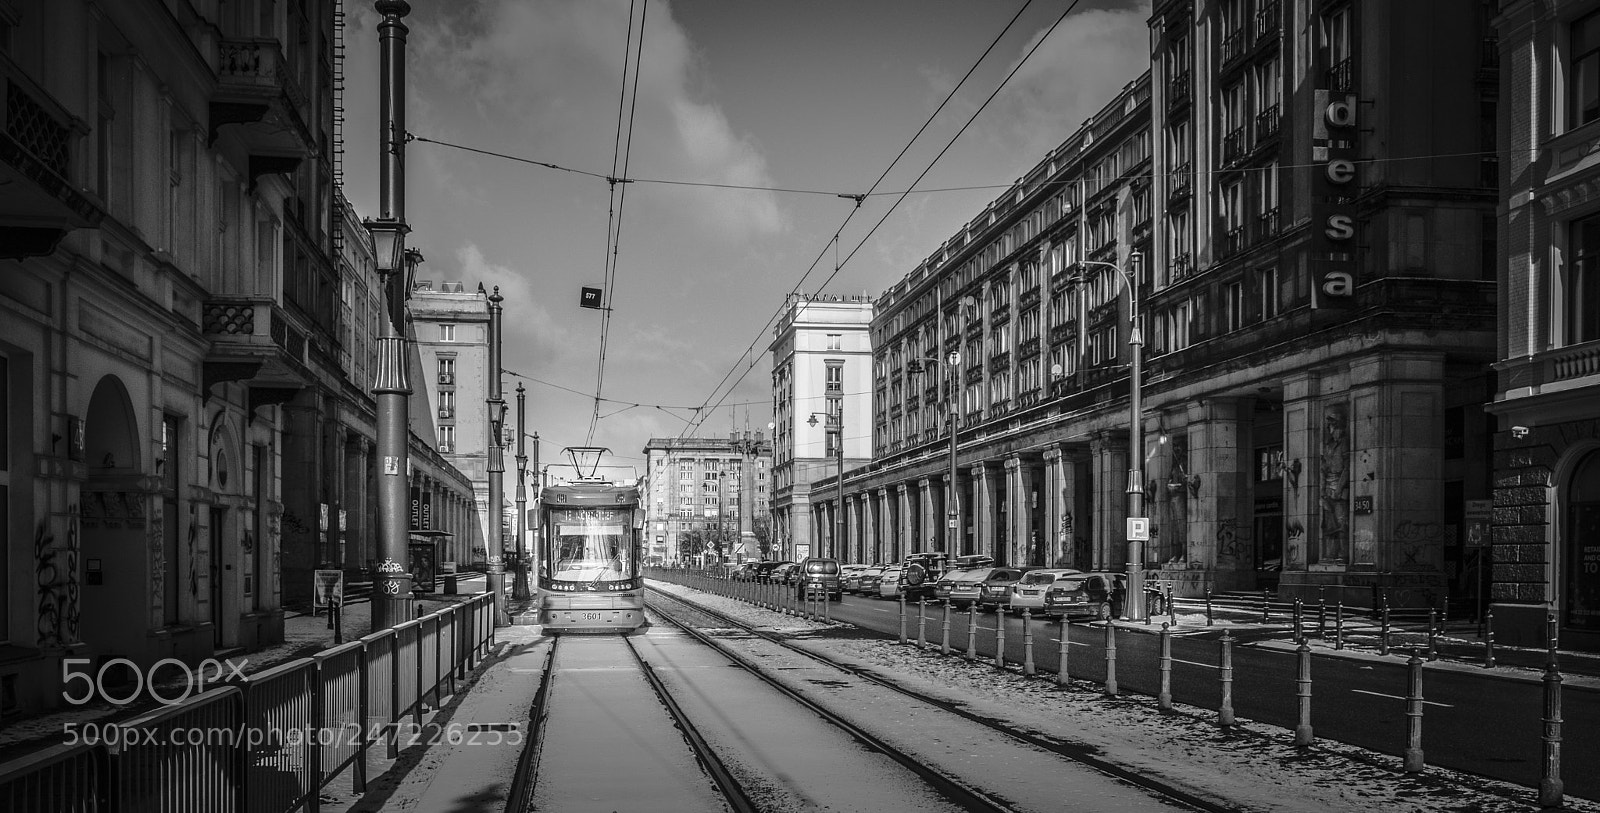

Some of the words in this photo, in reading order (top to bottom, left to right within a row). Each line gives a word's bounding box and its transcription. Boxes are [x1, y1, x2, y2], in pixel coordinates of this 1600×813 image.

[1323, 95, 1357, 297] desa
[411, 499, 419, 528] OUTLET
[422, 503, 430, 530] OUTLET
[1132, 520, 1145, 538] P
[1583, 562, 1598, 574] TO
[581, 612, 602, 621] 3601
